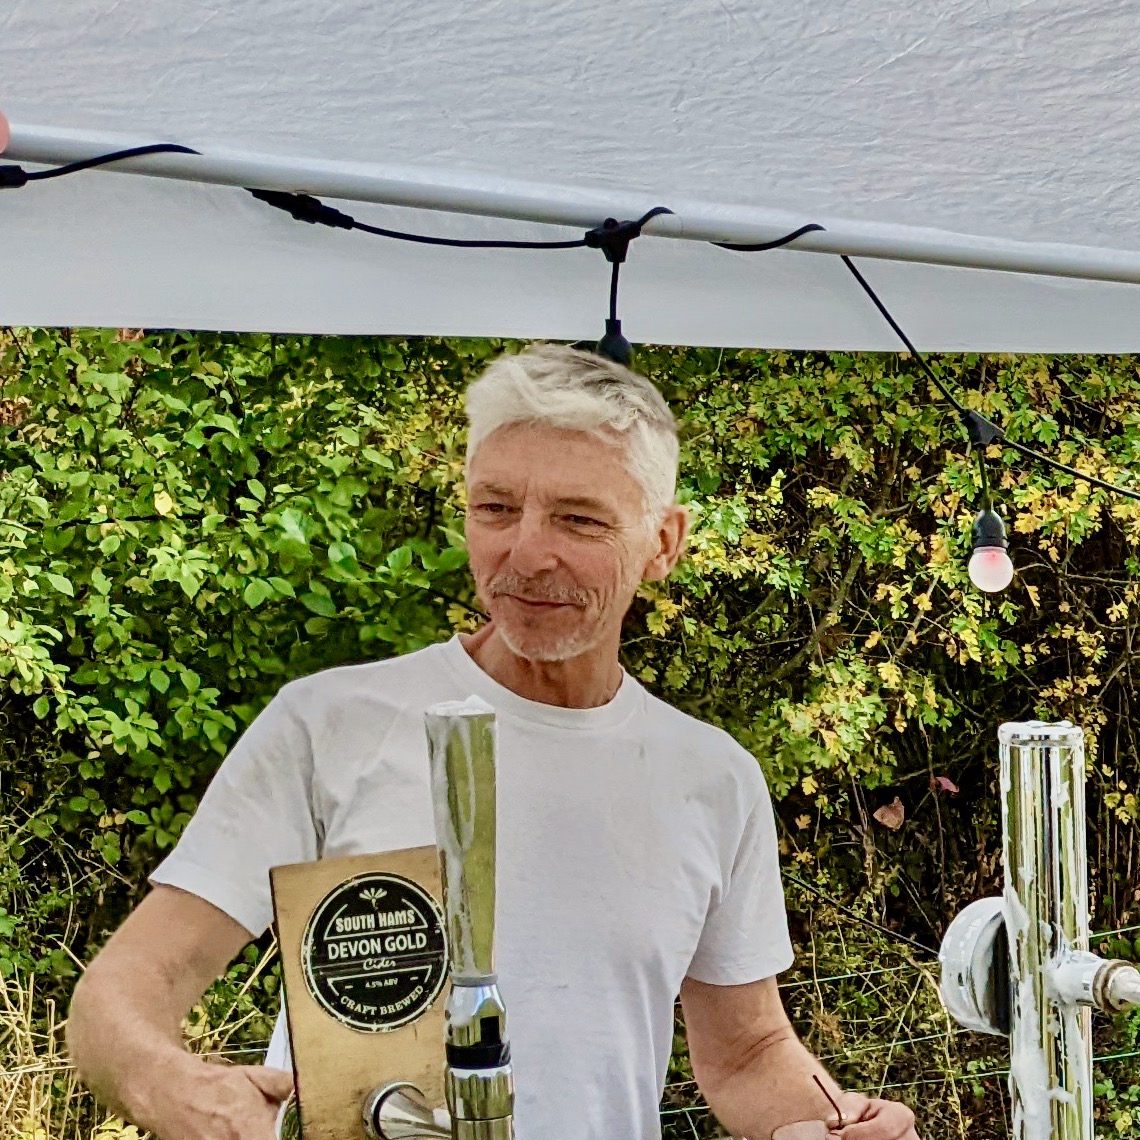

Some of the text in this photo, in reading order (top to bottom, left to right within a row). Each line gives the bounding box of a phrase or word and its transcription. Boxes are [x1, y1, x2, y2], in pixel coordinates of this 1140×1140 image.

[335, 909, 416, 933] SOUTH HAMS
[327, 932, 427, 960] DEVON GOLD
[363, 957, 396, 970] Cider
[340, 985, 424, 1015] CRAFT BREWED
